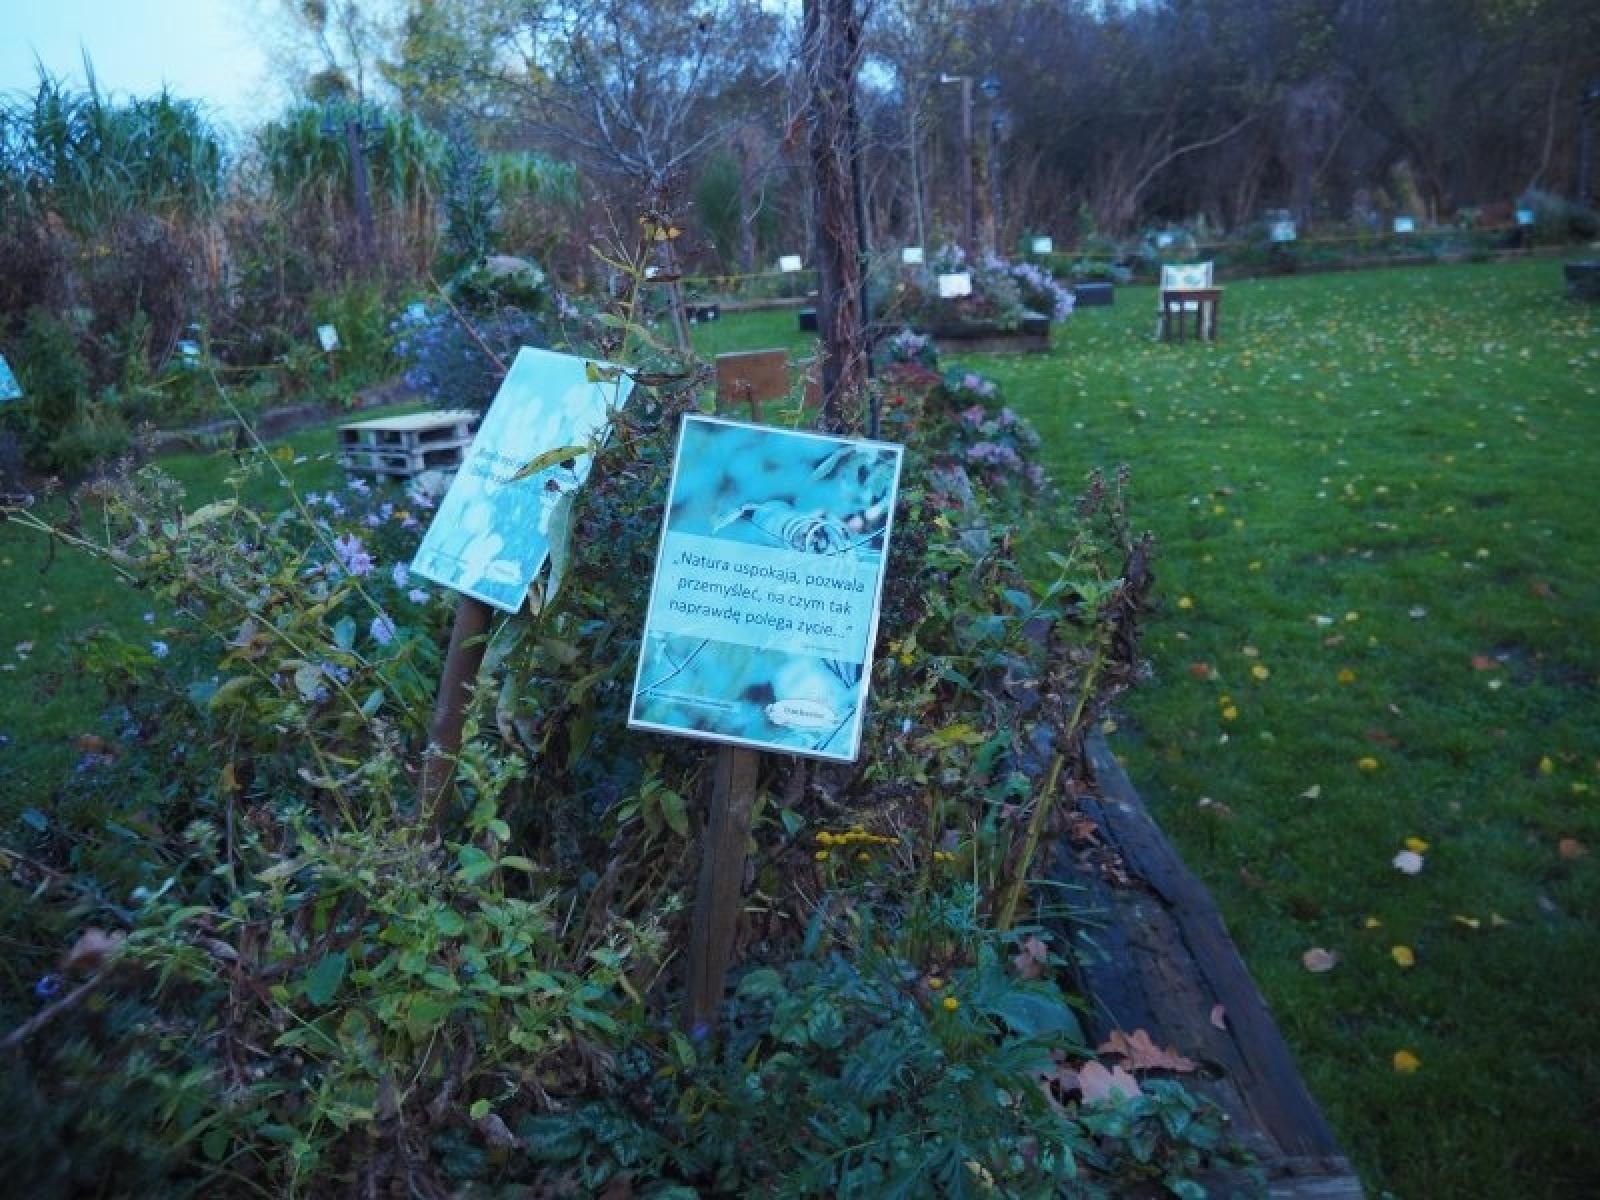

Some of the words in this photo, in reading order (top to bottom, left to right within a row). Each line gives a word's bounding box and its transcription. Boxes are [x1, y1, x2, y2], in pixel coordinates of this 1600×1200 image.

[734, 563, 801, 584] uspokaja,
[805, 575, 864, 593] pozwala
[669, 599, 741, 625] naprawdę
[745, 612, 793, 631] polega
[767, 591, 785, 605] na
[788, 594, 825, 612] czym
[829, 601, 853, 615] tak
